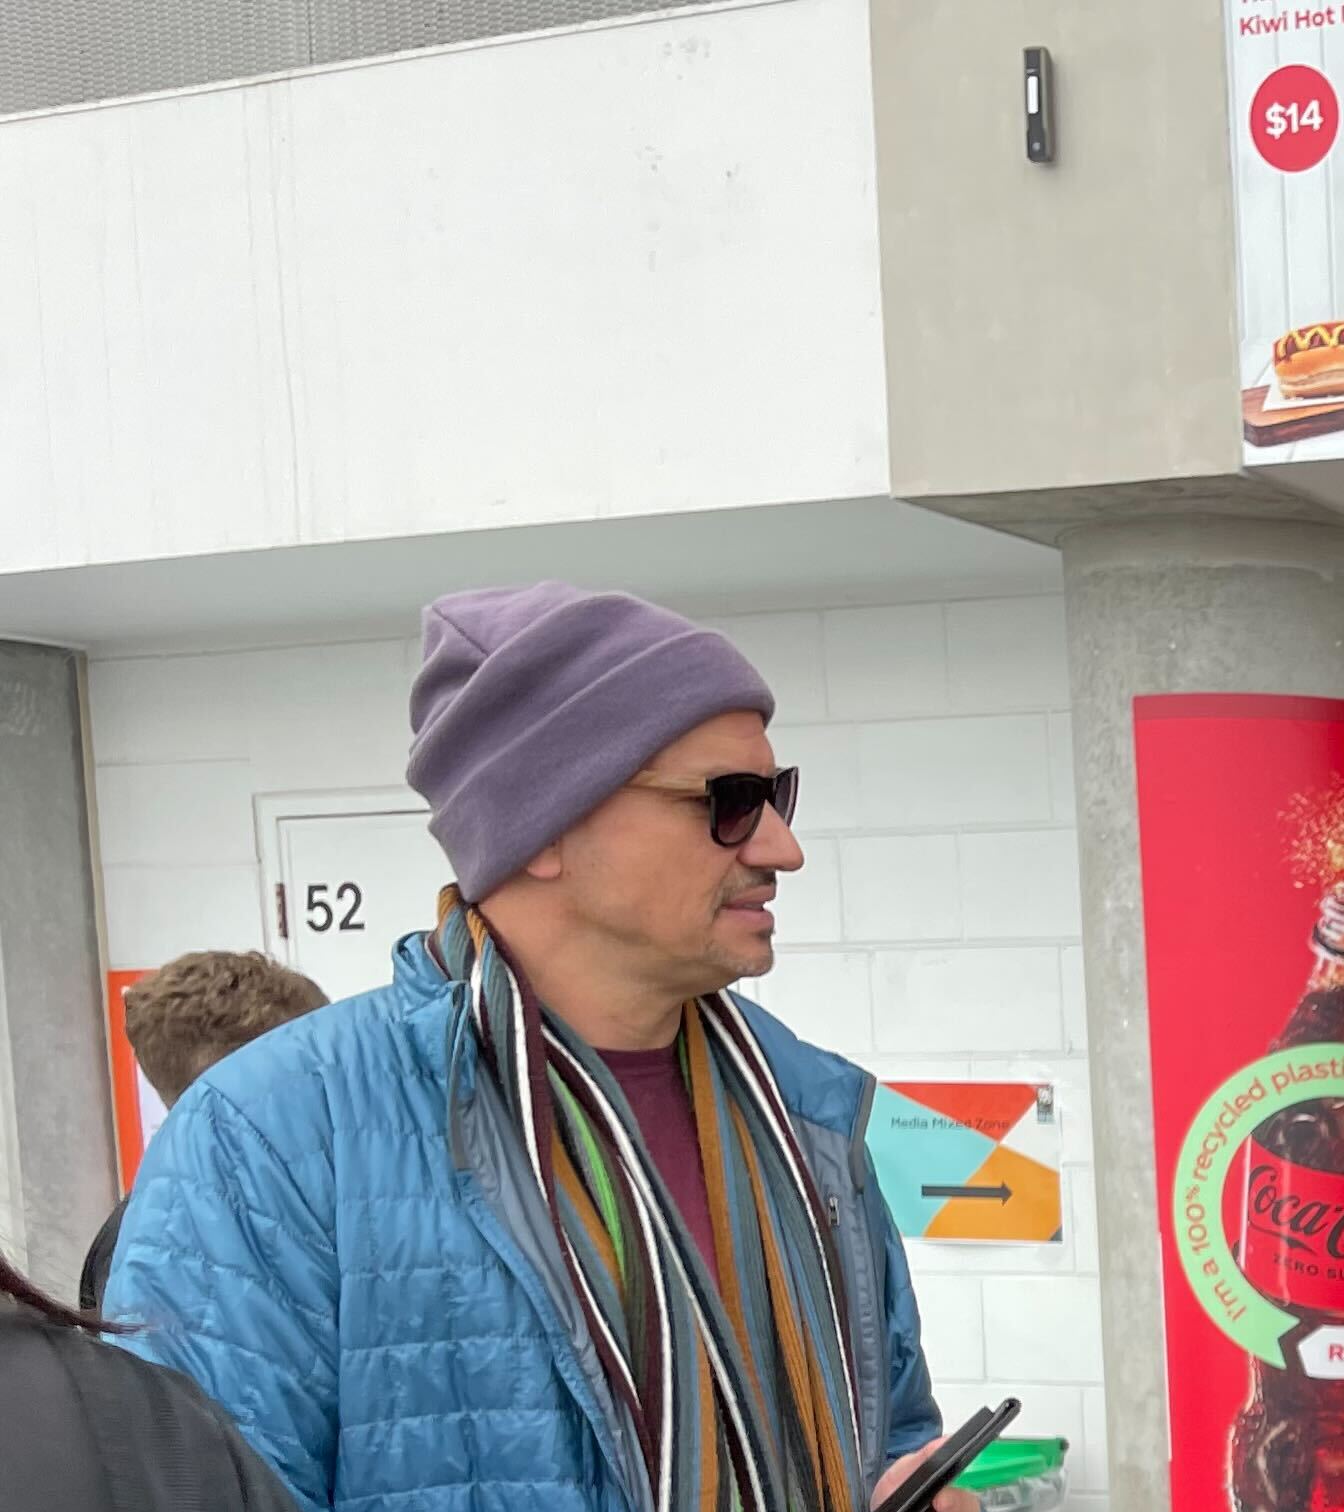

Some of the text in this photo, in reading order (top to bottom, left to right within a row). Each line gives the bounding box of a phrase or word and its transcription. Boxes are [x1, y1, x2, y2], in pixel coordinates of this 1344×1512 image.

[1239, 11, 1288, 36] Kiwi
[1294, 7, 1335, 30] Hot
[1265, 100, 1323, 139] $14
[306, 881, 366, 933] 52
[890, 1117, 1010, 1130] Media Mixed Zone
[1193, 1076, 1269, 1182] recycled
[1185, 1183, 1211, 1255] 100%
[1202, 1258, 1220, 1276] a
[1273, 1253, 1320, 1277] ZERO
[1213, 1279, 1248, 1323] I'm
